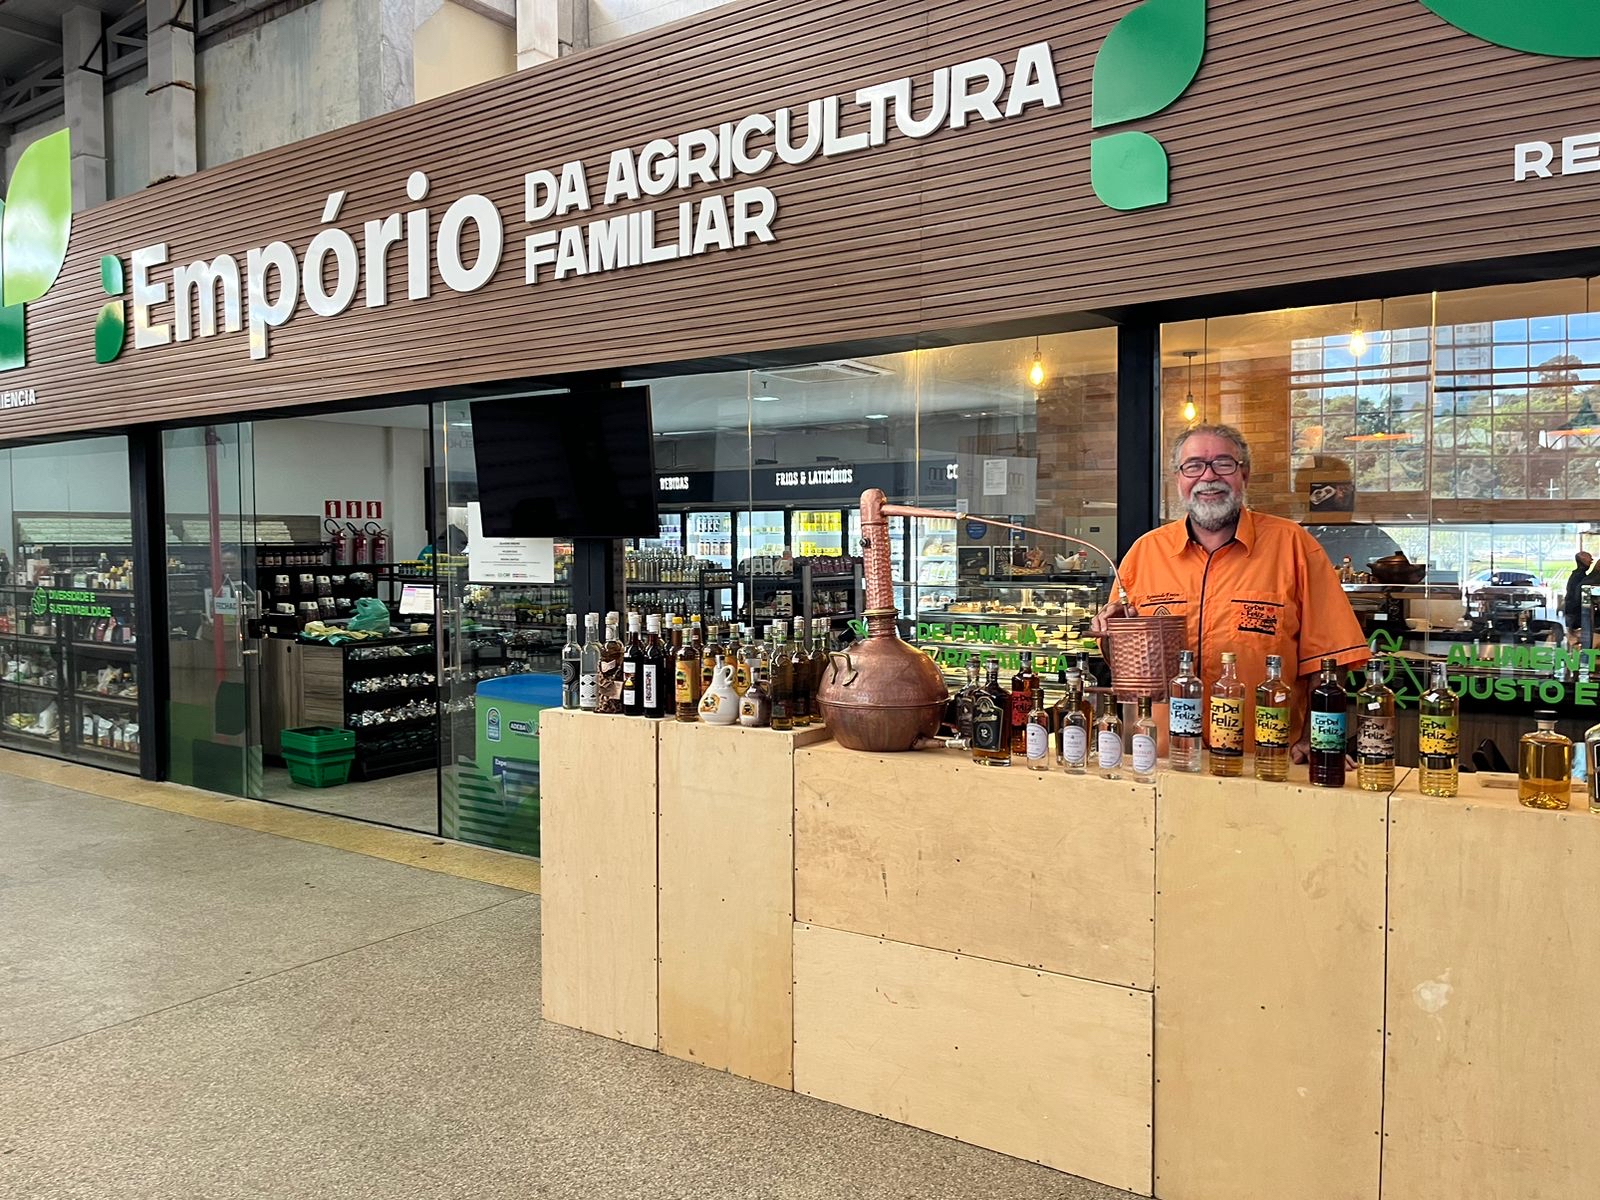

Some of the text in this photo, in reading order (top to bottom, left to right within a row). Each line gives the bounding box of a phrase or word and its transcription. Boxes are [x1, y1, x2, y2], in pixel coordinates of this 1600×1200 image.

[524, 41, 1062, 223] DA AGRICULTURA
[1514, 132, 1600, 182] RE
[524, 186, 778, 285] FAMILIAR
[131, 171, 504, 361] Empório
[775, 472, 799, 486] FRIOS
[917, 622, 946, 640] DE
[980, 650, 1068, 673] FAMLIA
[1447, 674, 1600, 706] JUSTO E
[1211, 712, 1239, 727] Feliz
